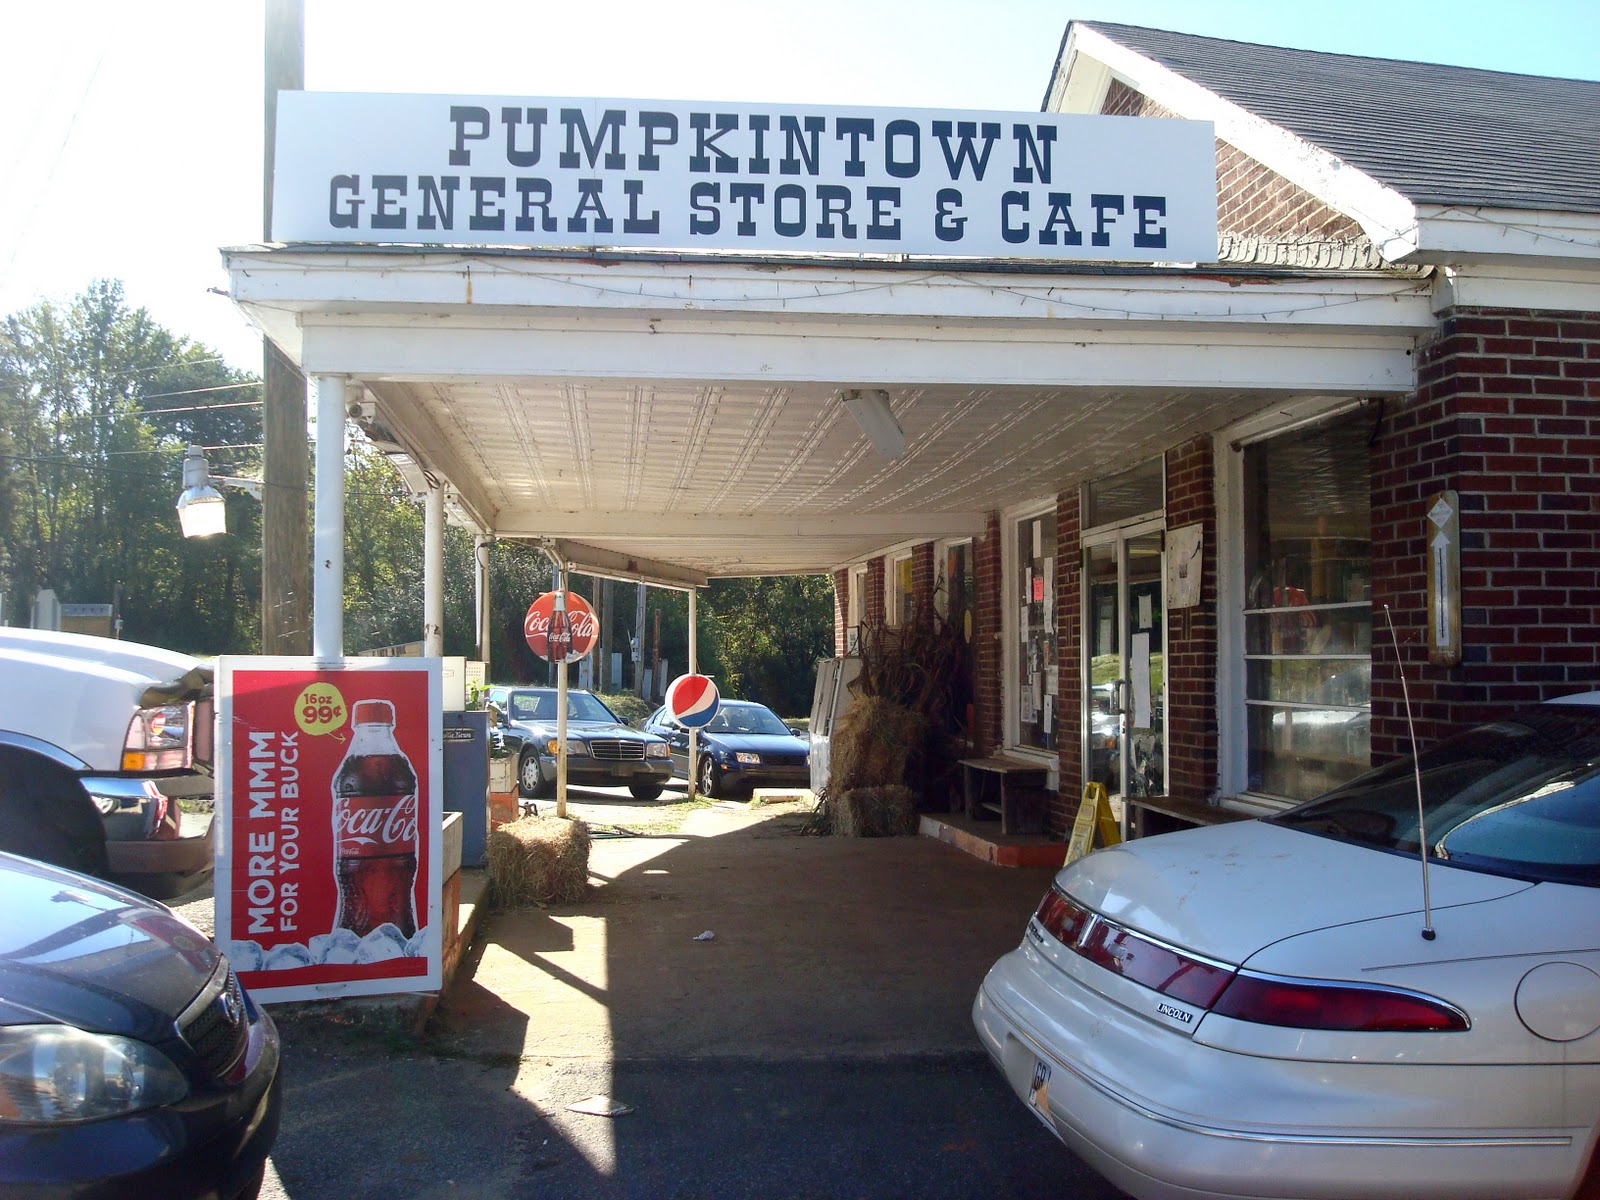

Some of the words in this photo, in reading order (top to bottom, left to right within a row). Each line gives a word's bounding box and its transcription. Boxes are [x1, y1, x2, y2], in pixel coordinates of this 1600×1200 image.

[449, 105, 1057, 184] PUMPKINTOWN
[329, 174, 660, 234] GENERAL
[689, 182, 901, 241] STORE
[935, 188, 968, 242] &
[1001, 190, 1167, 249] CAFE
[248, 731, 276, 818] MMM
[279, 731, 299, 797] BUCK
[279, 807, 299, 874] YOUR
[247, 831, 275, 934] MORE
[279, 890, 299, 932] FOR
[1157, 1003, 1191, 1022] LINCOLN
